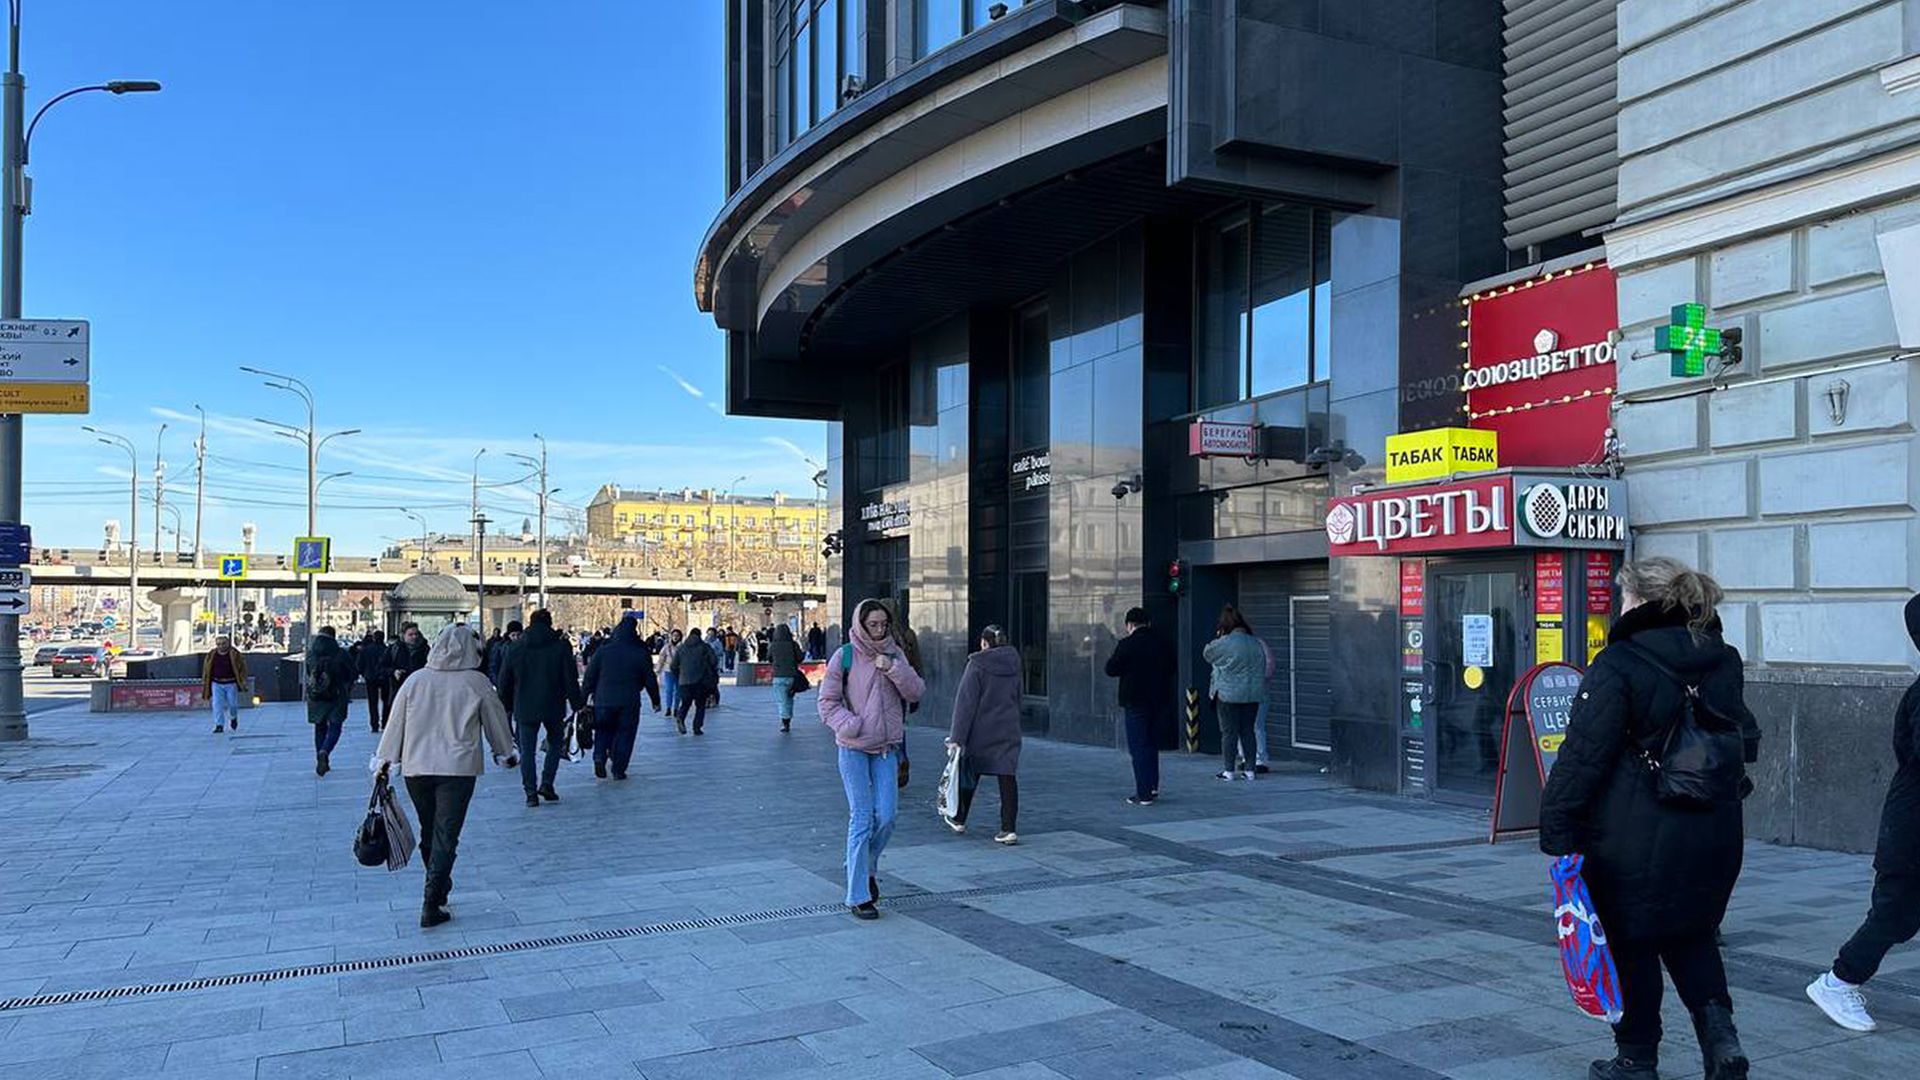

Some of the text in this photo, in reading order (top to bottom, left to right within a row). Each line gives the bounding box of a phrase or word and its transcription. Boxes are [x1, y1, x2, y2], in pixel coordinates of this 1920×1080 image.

[1390, 446, 1444, 467] ТАБАК
[1452, 446, 1495, 463] ТАБАК
[1567, 485, 1609, 510] ДАРЫ
[1354, 486, 1509, 550] ЦВЕТЫ
[1567, 513, 1625, 540] СИБИРИ
[1533, 694, 1576, 708] СЕРВИС
